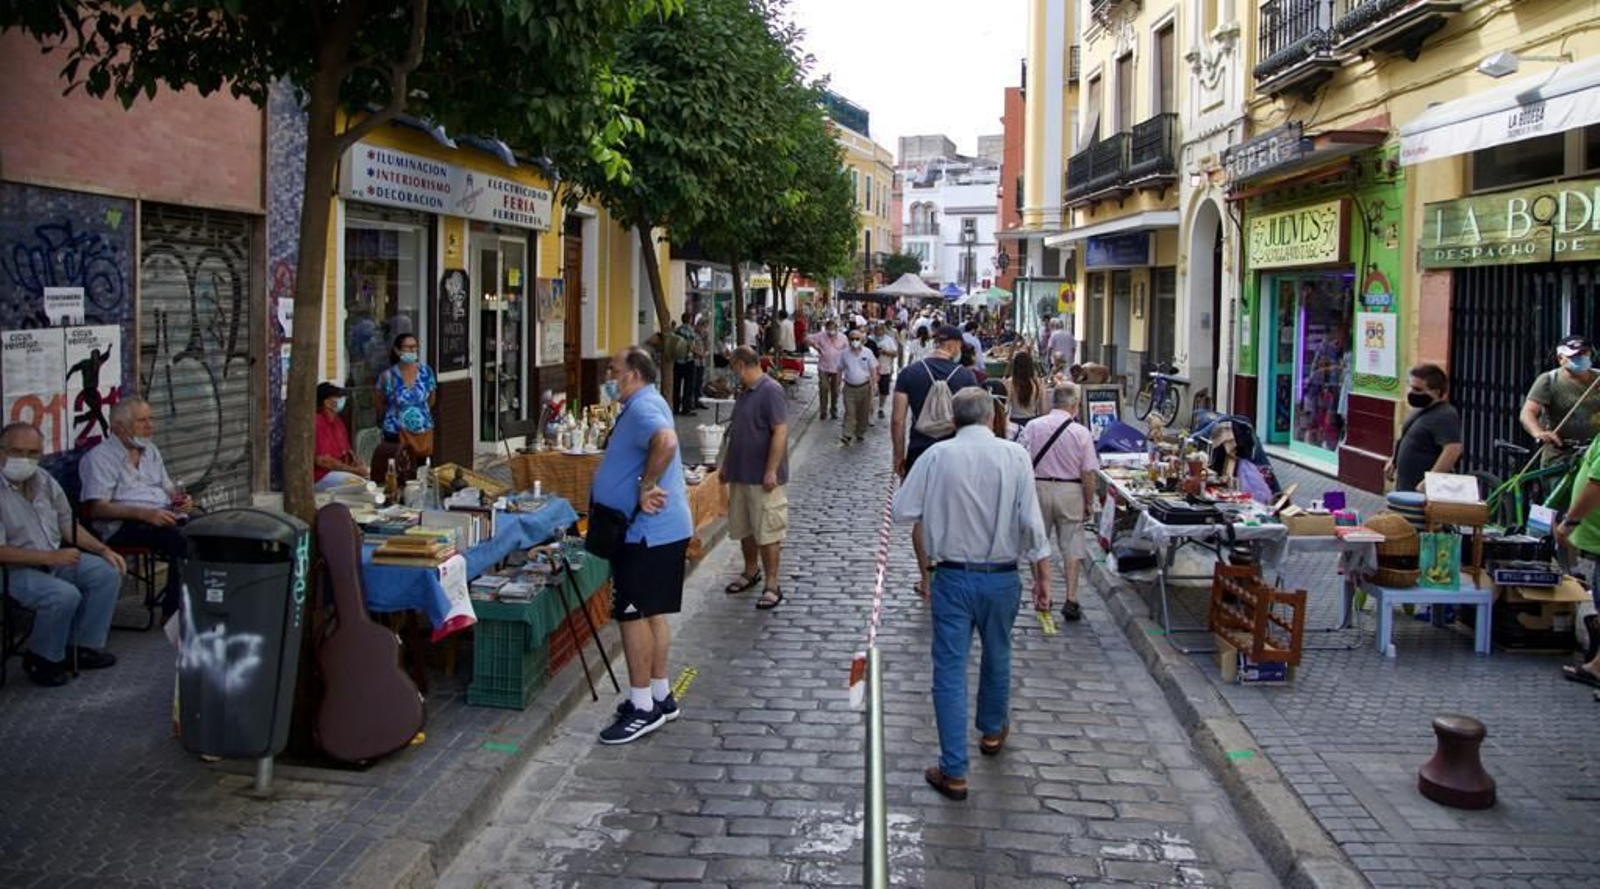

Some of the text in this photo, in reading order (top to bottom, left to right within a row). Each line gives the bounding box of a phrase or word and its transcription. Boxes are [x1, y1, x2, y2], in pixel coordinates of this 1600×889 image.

[376, 151, 447, 177] ILUMINACION
[376, 168, 451, 193] INTERIORISMO
[488, 179, 548, 200] ELECTRICIDAD
[376, 186, 443, 208] DECORACION
[503, 195, 535, 214] FERIA
[493, 209, 542, 226] FERRETERIA
[1265, 210, 1321, 247] JUEVES
[1437, 206, 1482, 246] LA
[1435, 238, 1586, 262] DESPACHO DE
